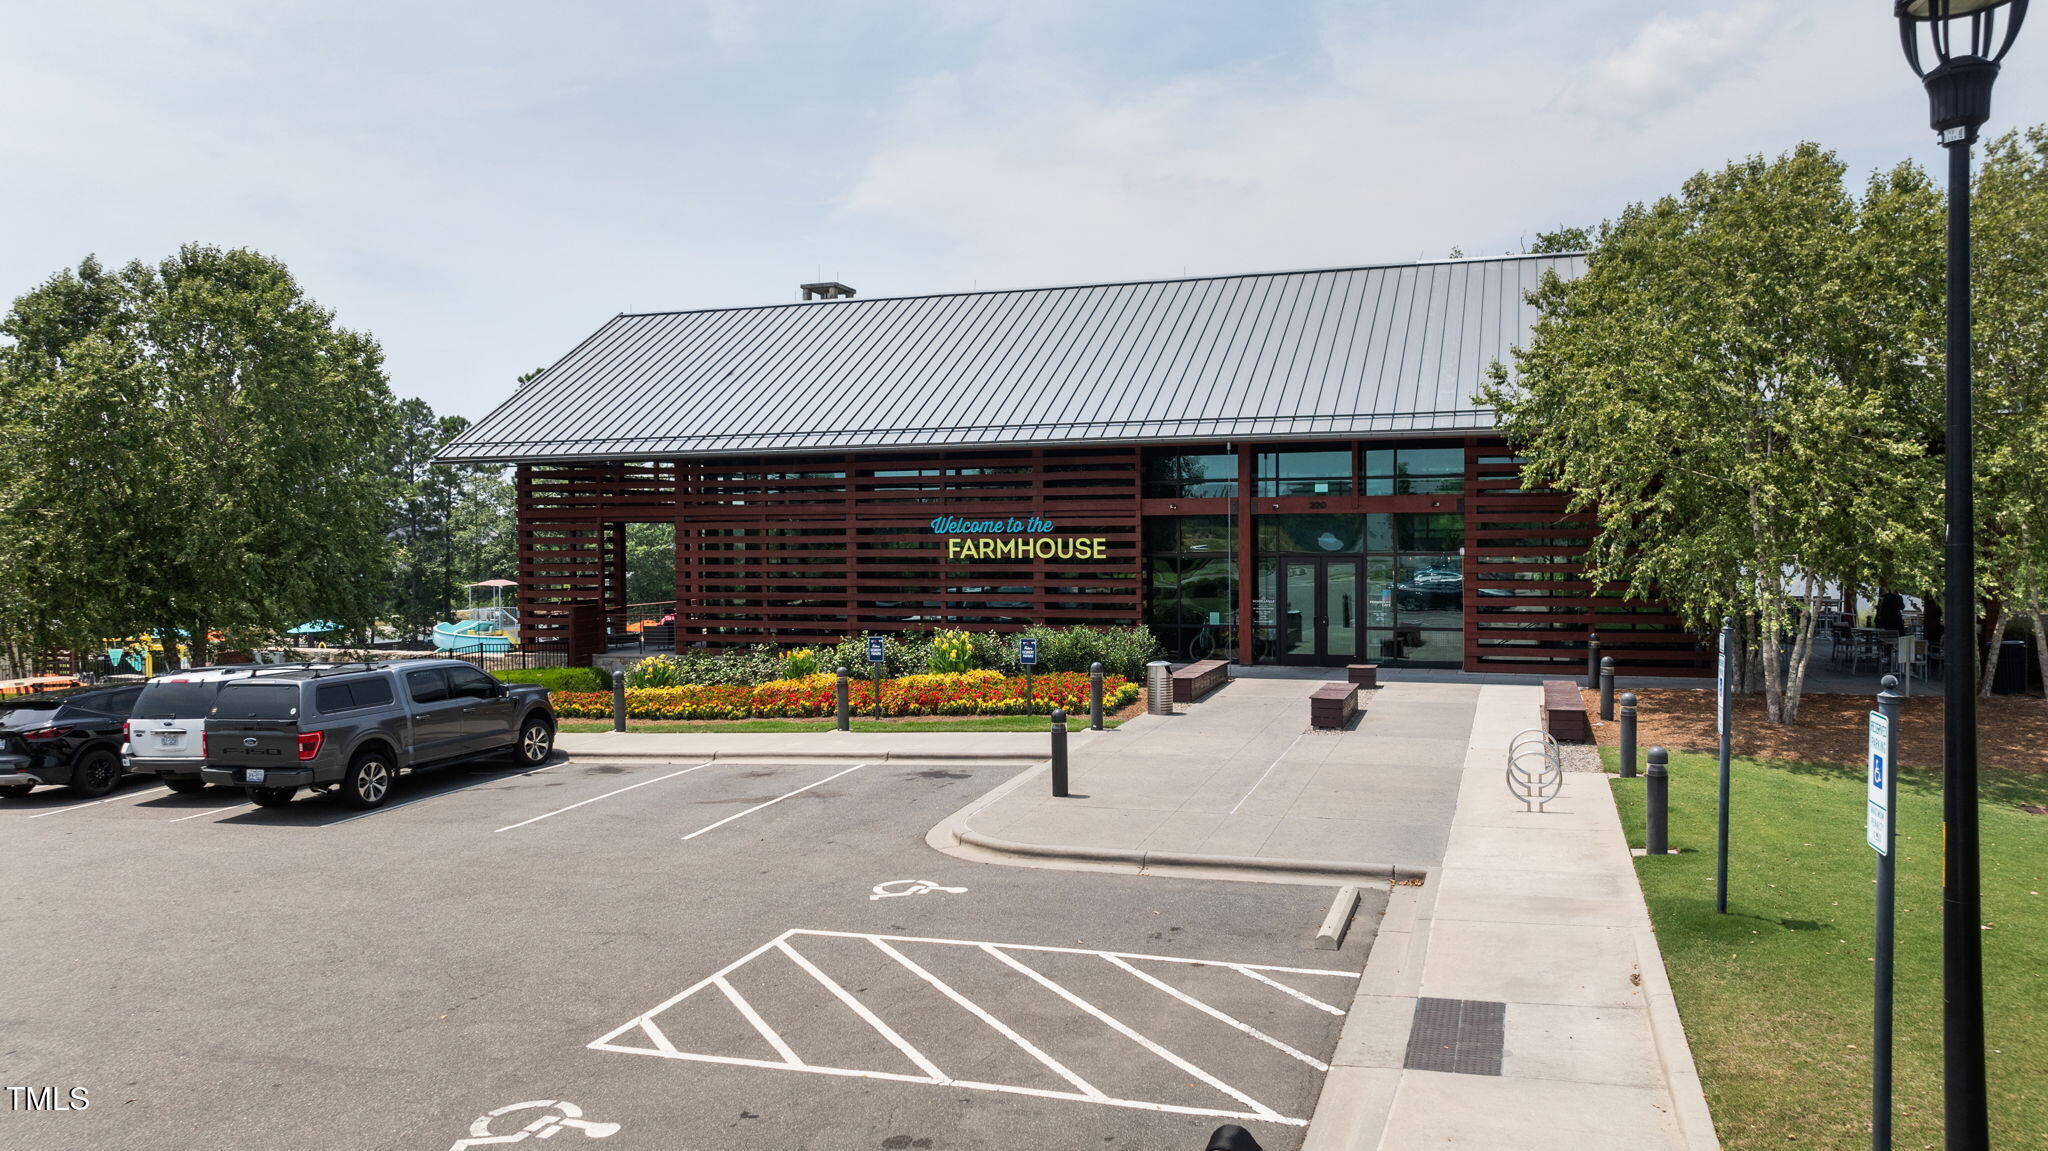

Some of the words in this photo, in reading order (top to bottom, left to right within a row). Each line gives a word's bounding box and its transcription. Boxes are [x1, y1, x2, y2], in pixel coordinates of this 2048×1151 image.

[930, 515, 1004, 534] Welcome
[1006, 517, 1025, 533] to
[1026, 516, 1054, 533] the
[948, 537, 1107, 559] FARMHOUSE
